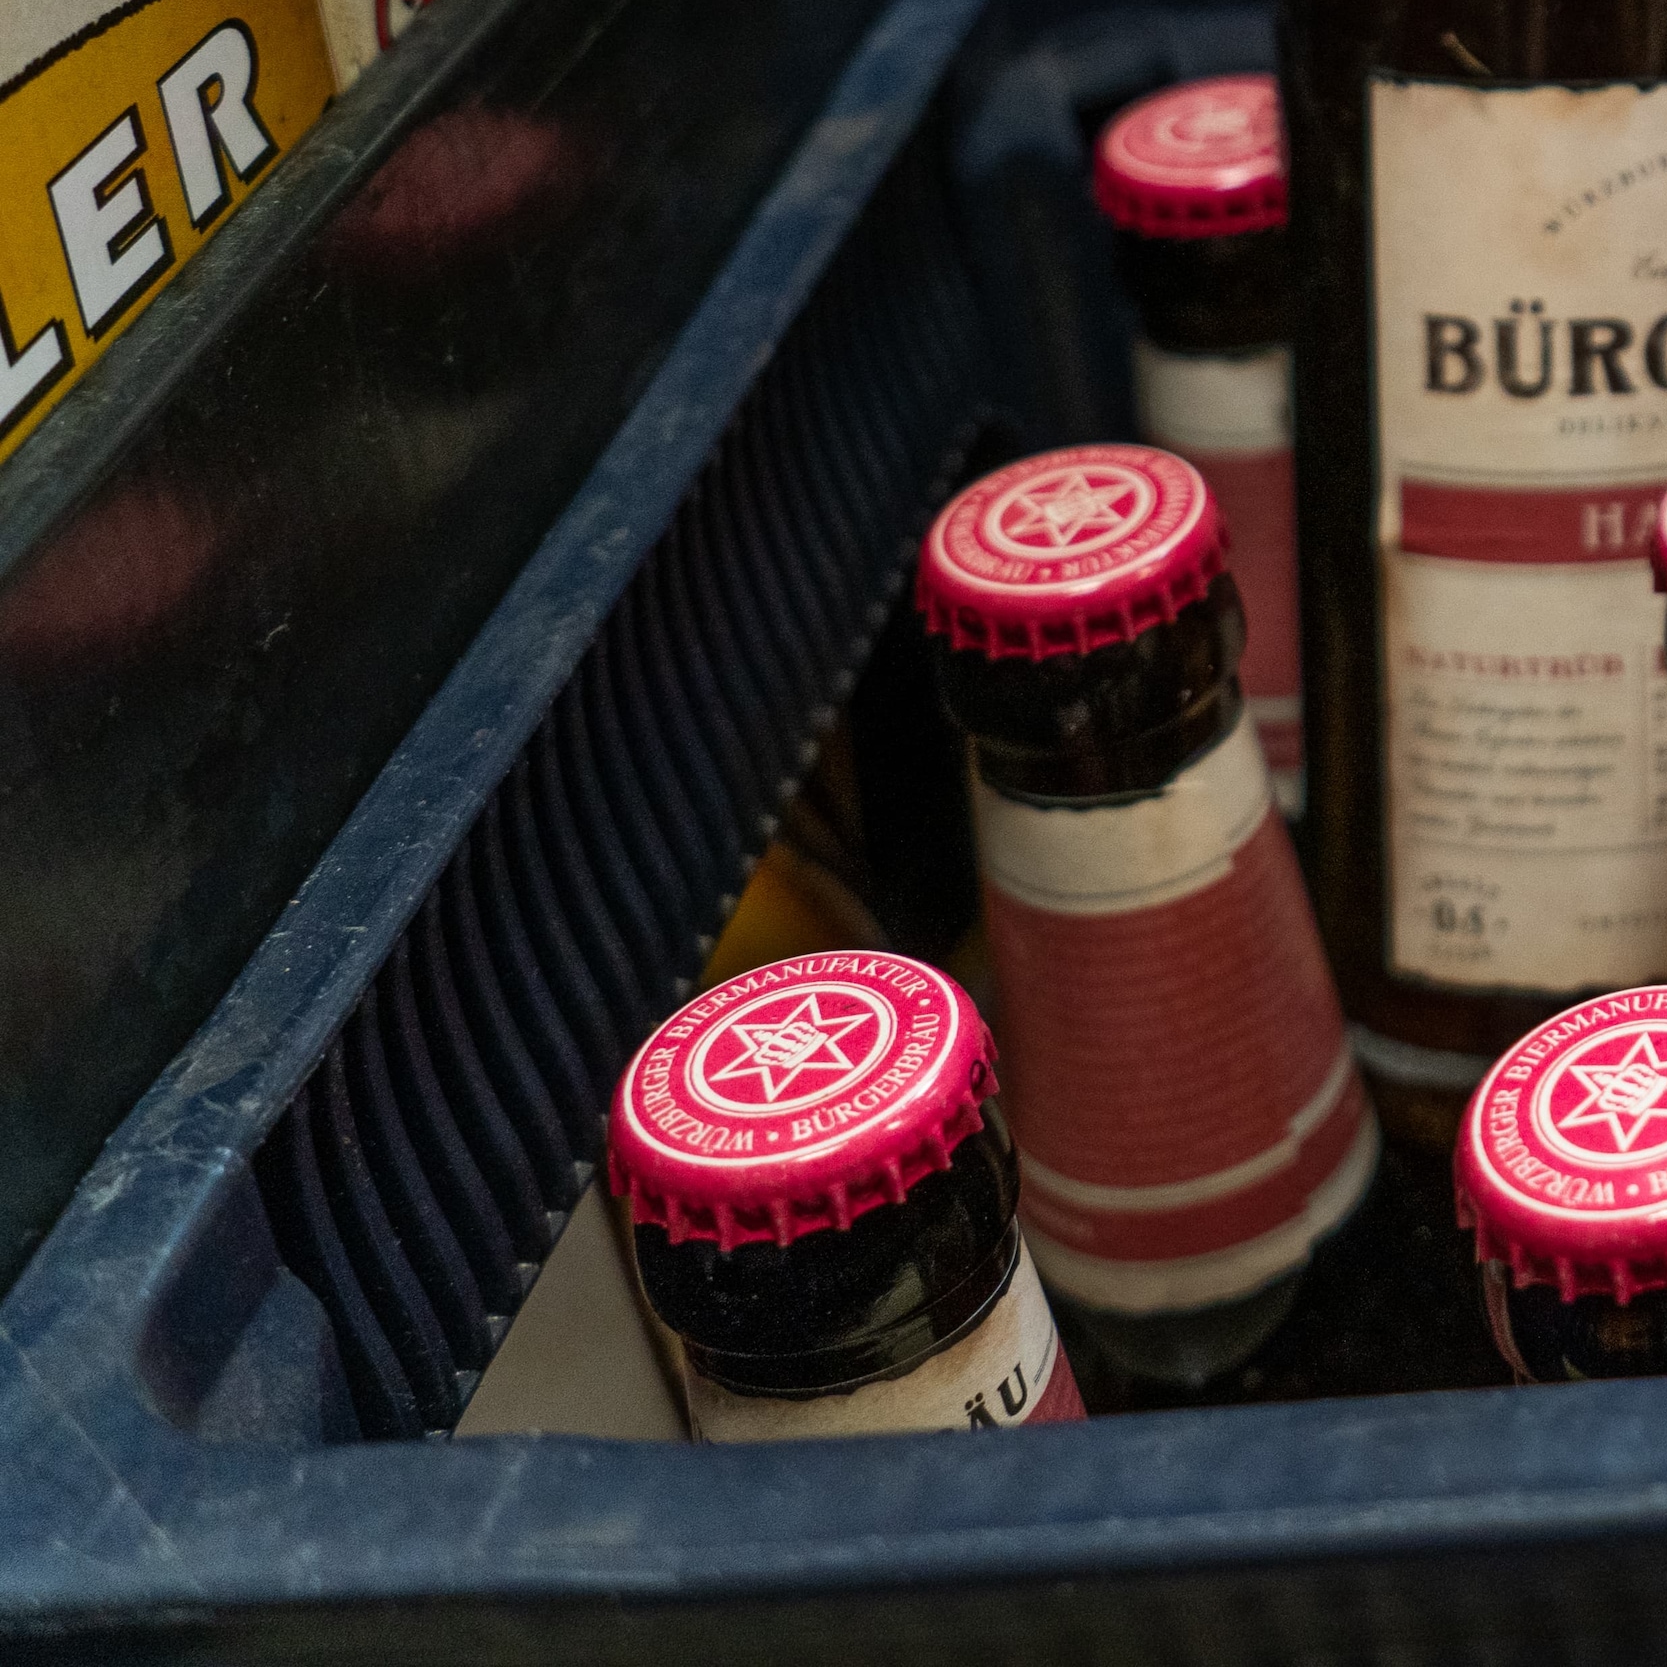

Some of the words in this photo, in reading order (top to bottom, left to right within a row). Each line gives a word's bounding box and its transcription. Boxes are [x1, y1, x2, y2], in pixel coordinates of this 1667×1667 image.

[666, 956, 929, 1041] BIERMANUFAKTUR
[642, 1046, 755, 1154] WÜRZBURGER
[791, 1012, 941, 1142] BÜRGERBRÄU
[1488, 1087, 1617, 1206] WÜRZBURGER
